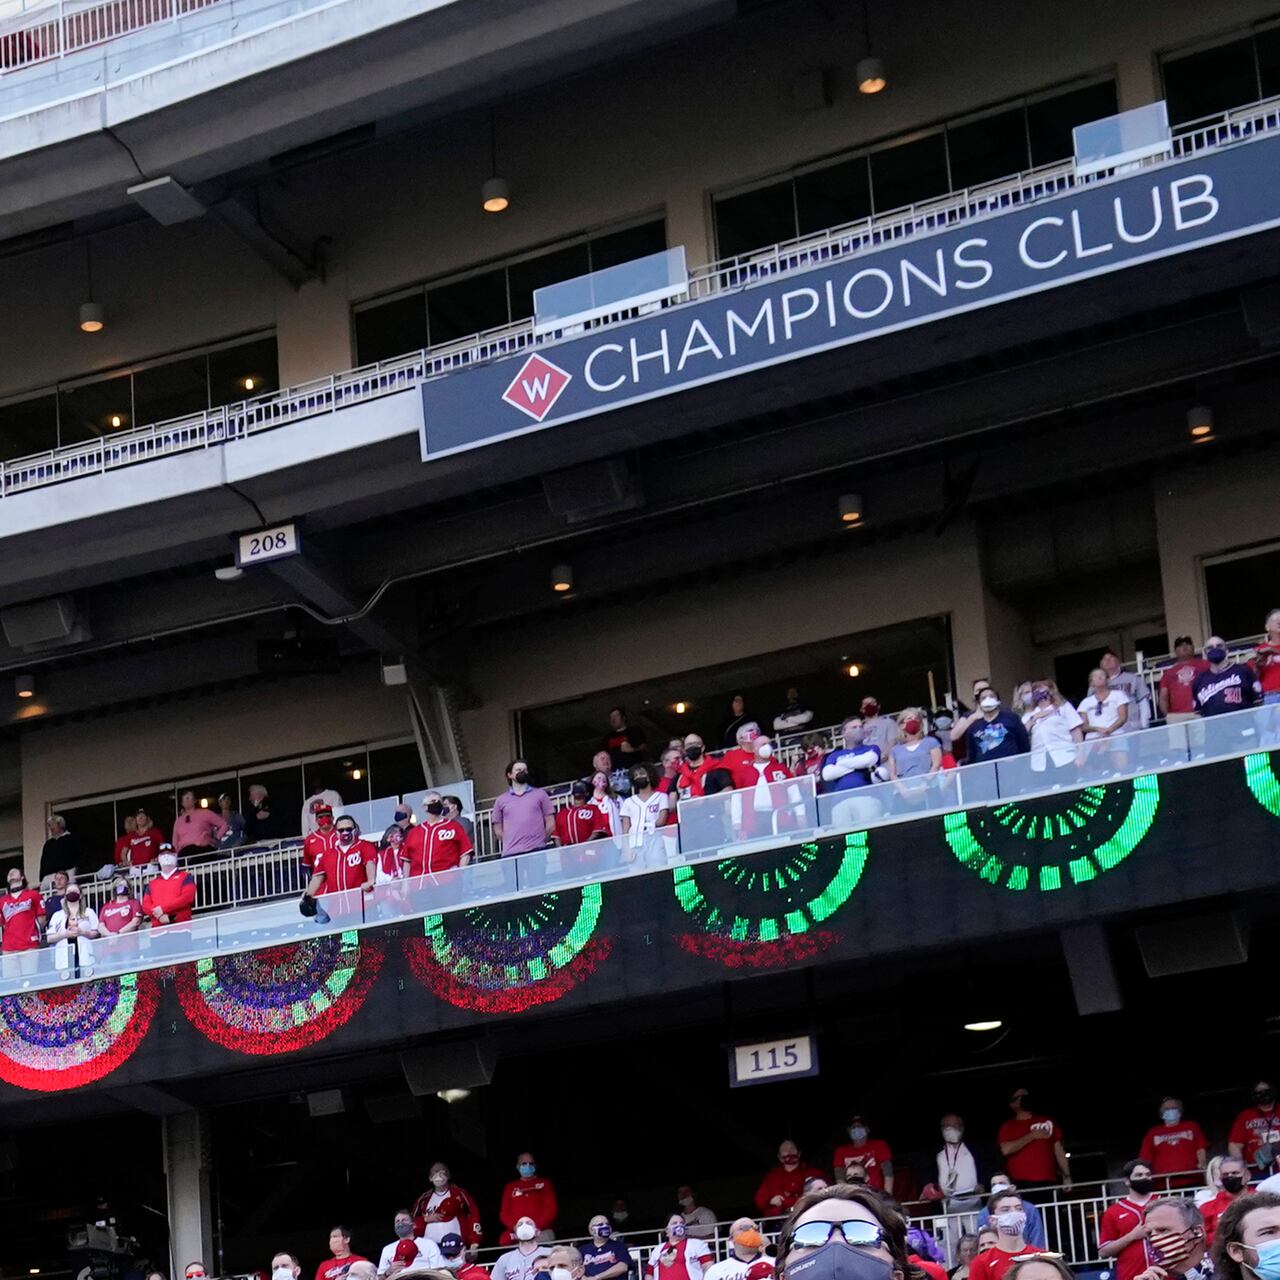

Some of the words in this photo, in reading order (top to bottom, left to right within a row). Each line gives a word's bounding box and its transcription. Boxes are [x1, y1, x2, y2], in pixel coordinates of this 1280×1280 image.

[522, 372, 551, 404] W
[583, 238, 993, 393] CHAMPIONS
[1018, 173, 1220, 270] CLUB
[250, 532, 287, 556] 208
[750, 1044, 798, 1072] 115
